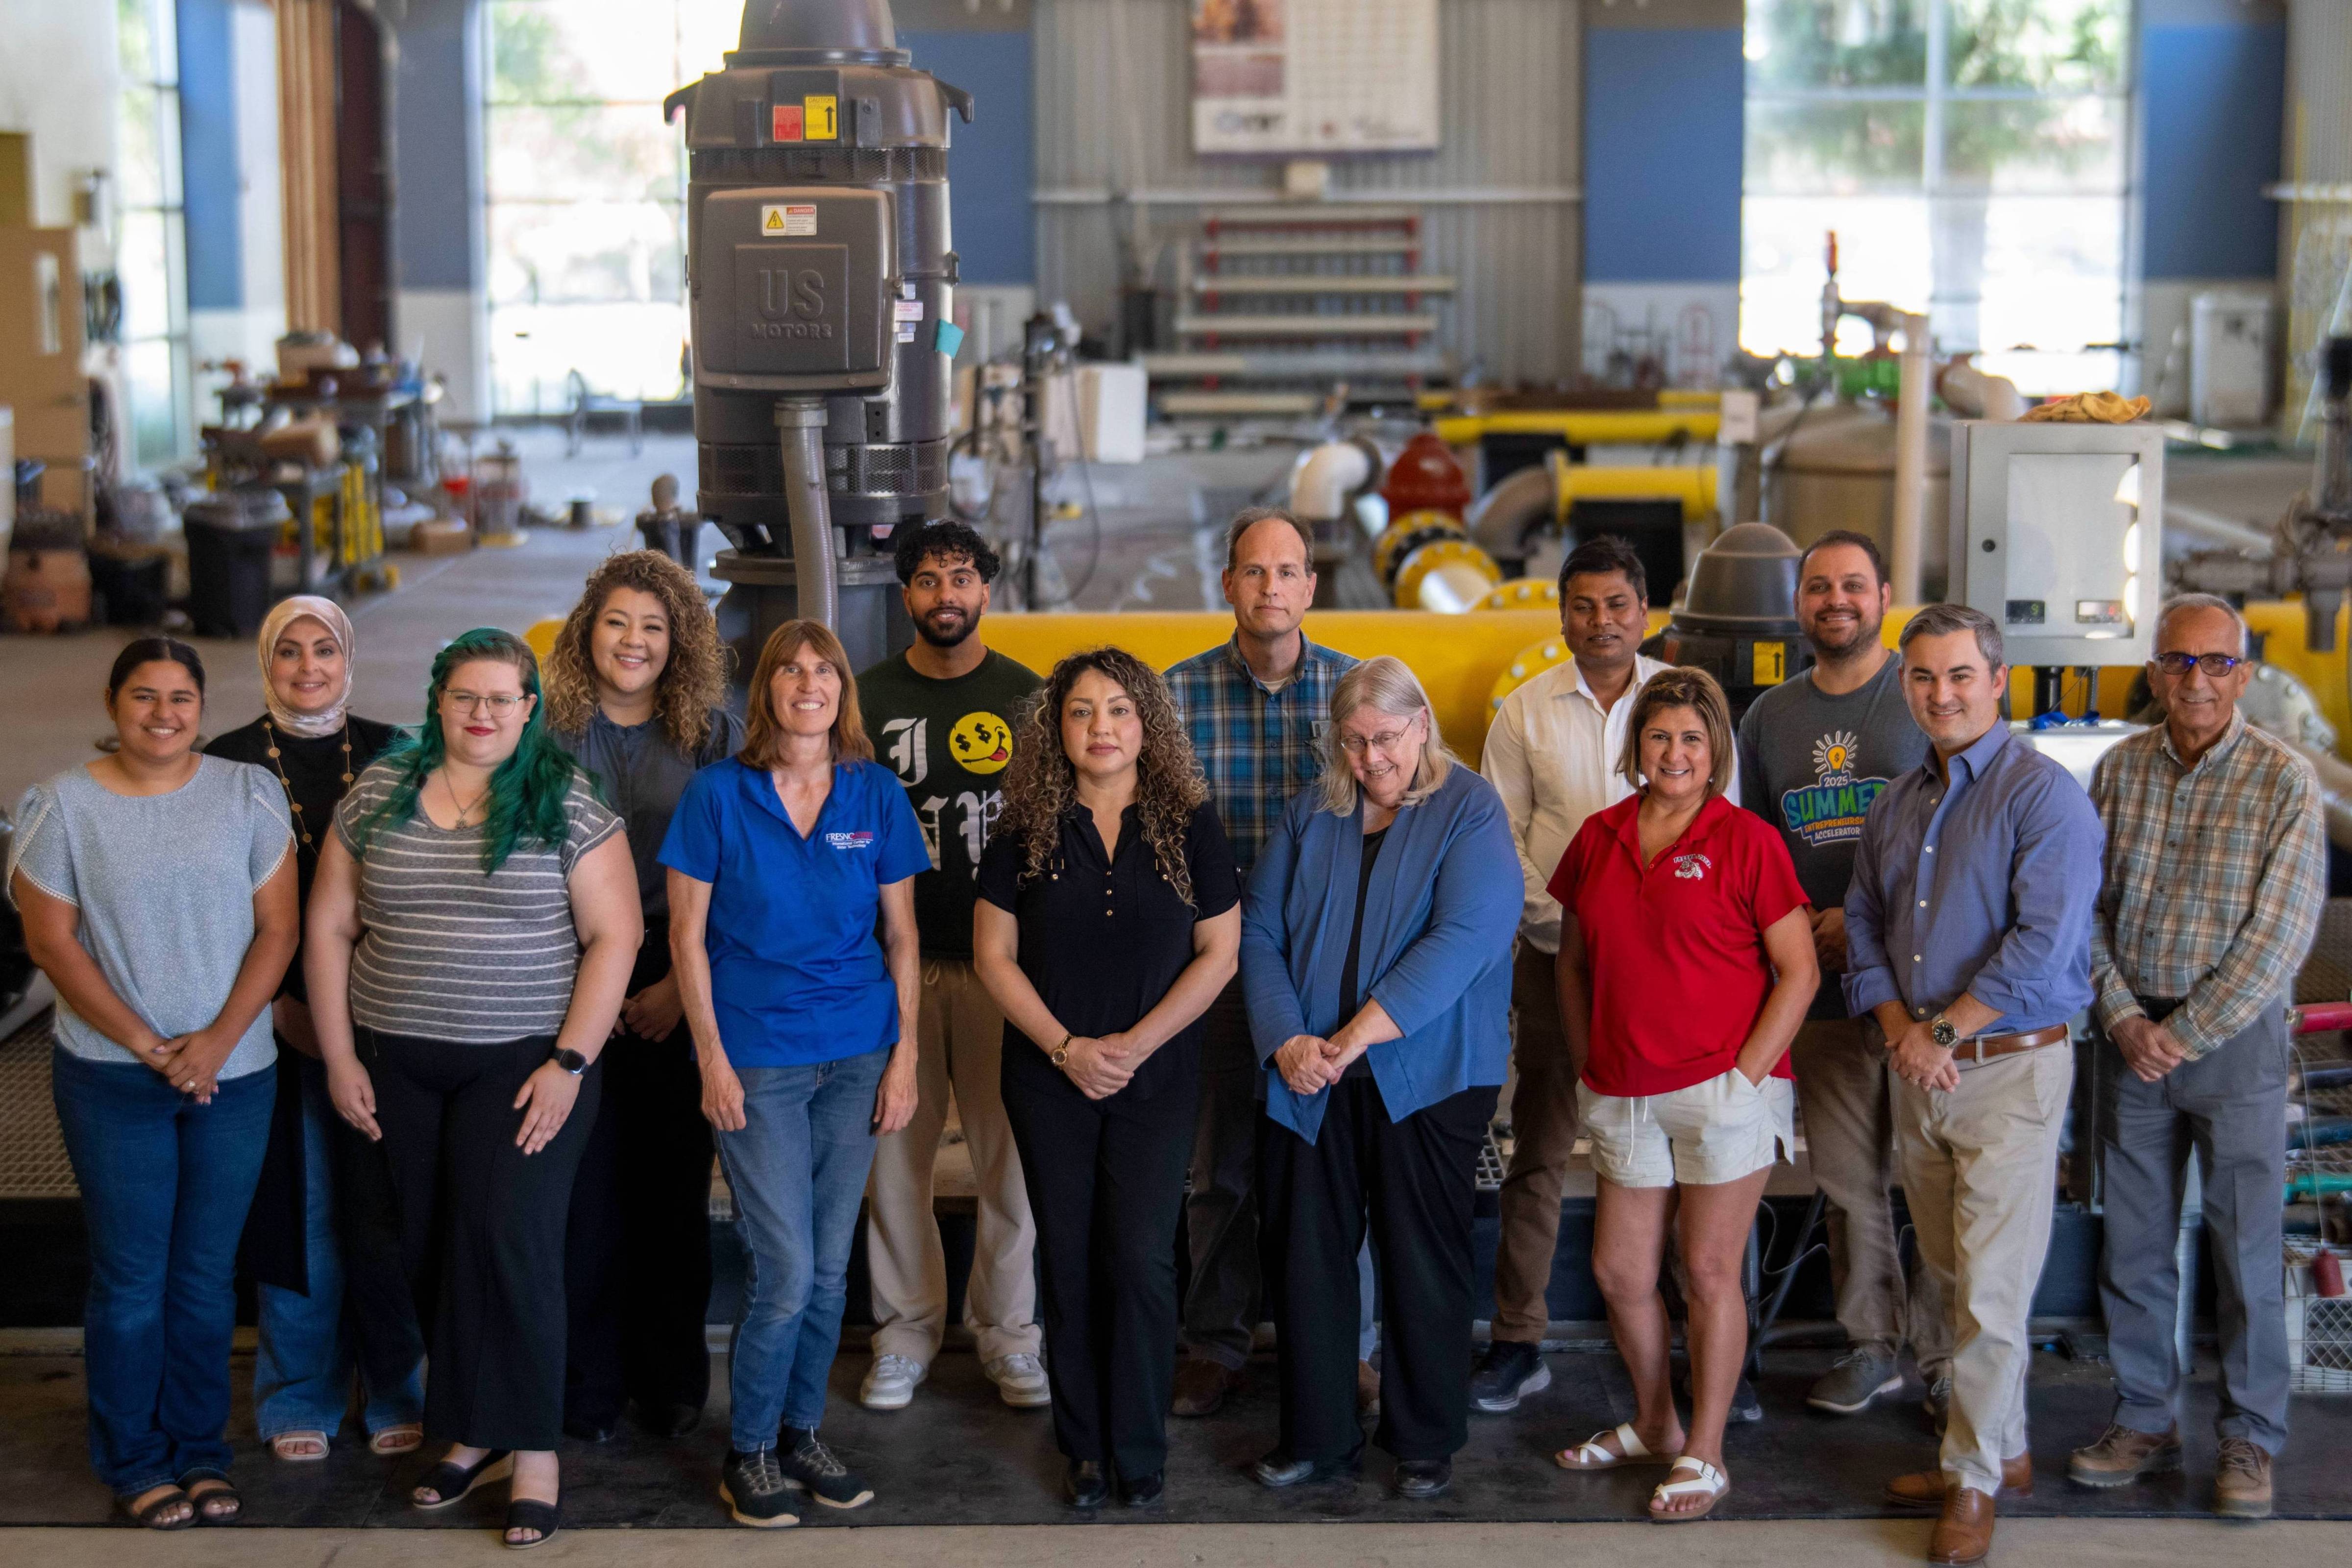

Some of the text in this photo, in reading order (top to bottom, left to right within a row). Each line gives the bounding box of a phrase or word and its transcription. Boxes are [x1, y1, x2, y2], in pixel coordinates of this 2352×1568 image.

[758, 270, 825, 321] US
[752, 324, 832, 339] MOTORS
[1824, 776, 1848, 787] 2025
[1786, 783, 1886, 827] SUMME
[1804, 816, 1866, 833] ENTREPRENEURSH
[1814, 827, 1860, 840] ACCELERATOR
